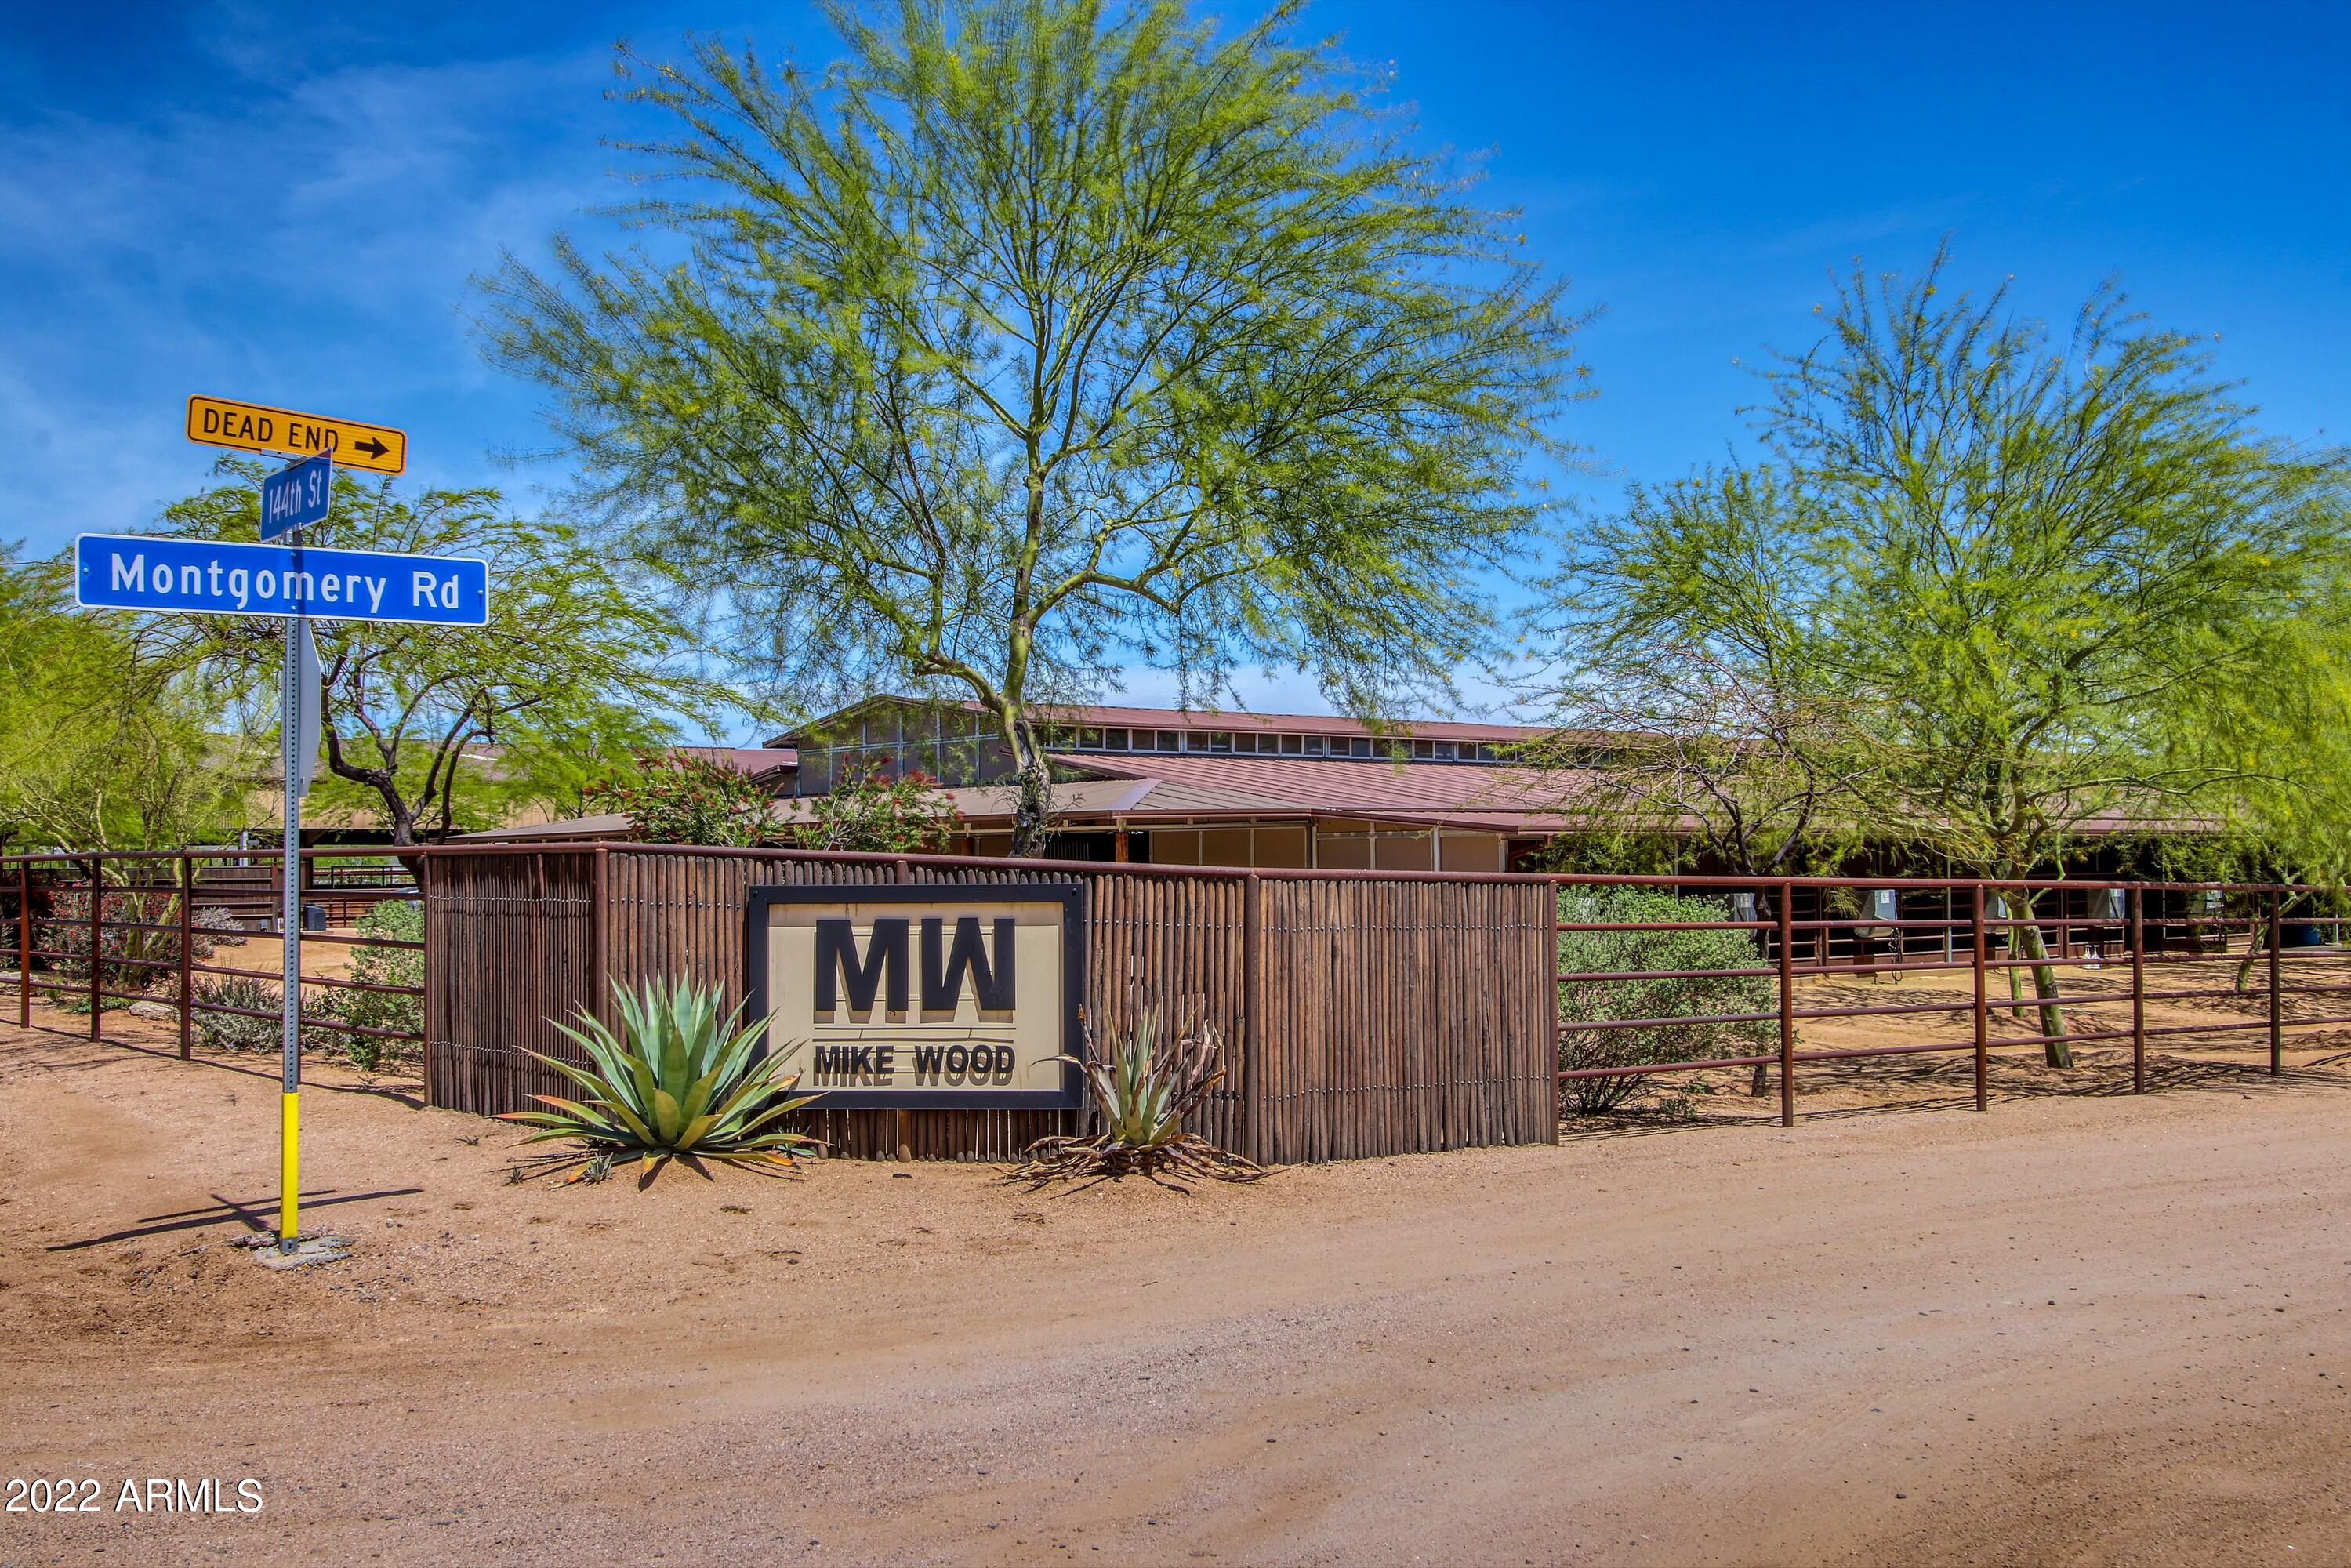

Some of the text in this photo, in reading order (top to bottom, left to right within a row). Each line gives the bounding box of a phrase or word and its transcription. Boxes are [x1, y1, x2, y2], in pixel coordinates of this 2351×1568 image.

[204, 408, 339, 452] DEAD END
[269, 469, 321, 524] 144th St
[111, 553, 459, 614] Montgomery Rd
[816, 917, 1016, 1011] MW
[815, 1044, 1016, 1074] MIKE WOOD
